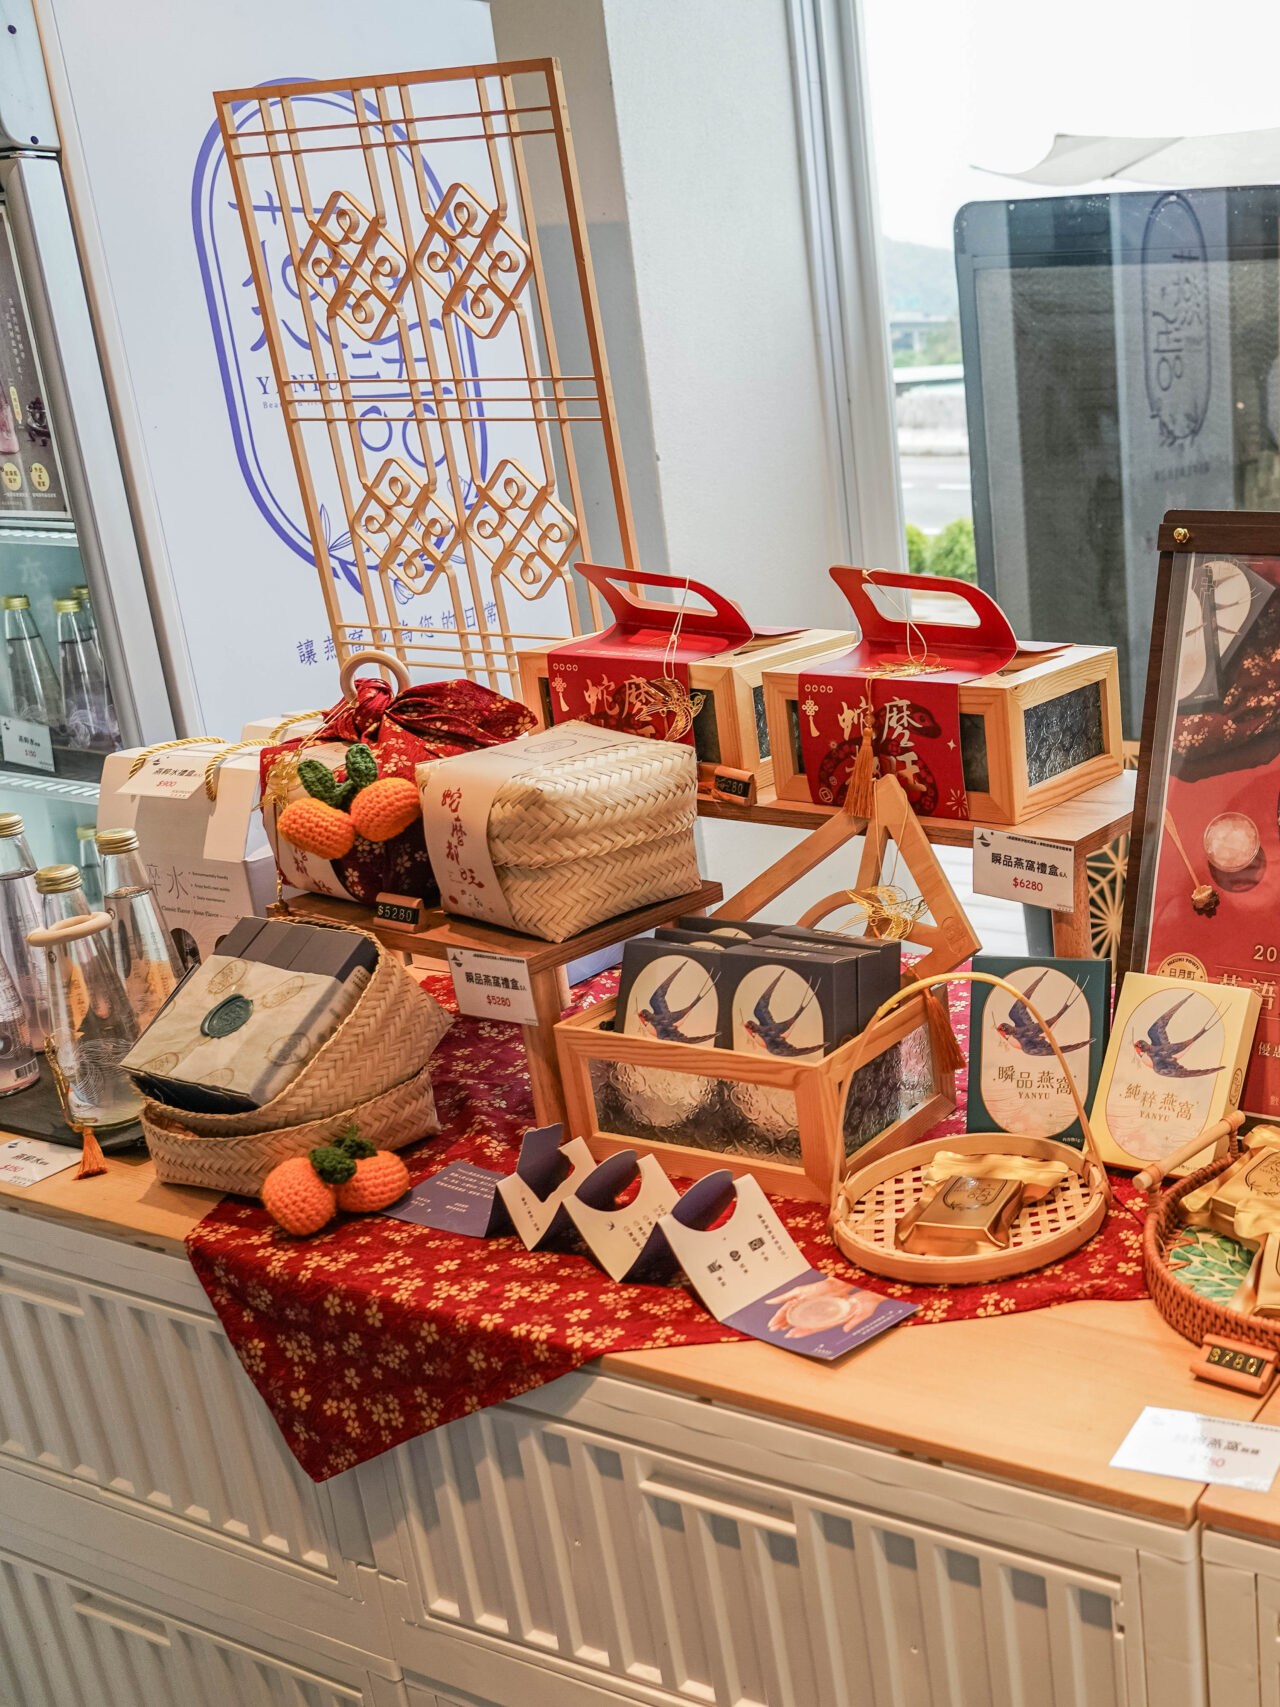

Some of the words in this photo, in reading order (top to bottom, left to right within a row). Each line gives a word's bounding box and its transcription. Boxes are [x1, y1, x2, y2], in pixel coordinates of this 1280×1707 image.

[1013, 877, 1044, 892] $6280
[378, 905, 413, 923] $5280
[1169, 967, 1196, 980] 日月町
[998, 1064, 1072, 1096] 瞬品燕窩
[1018, 1091, 1051, 1100] YANYU
[1124, 1082, 1195, 1121] 純粹燕窩
[1139, 1111, 1170, 1122] YANYU
[1209, 1347, 1258, 1373] $780
